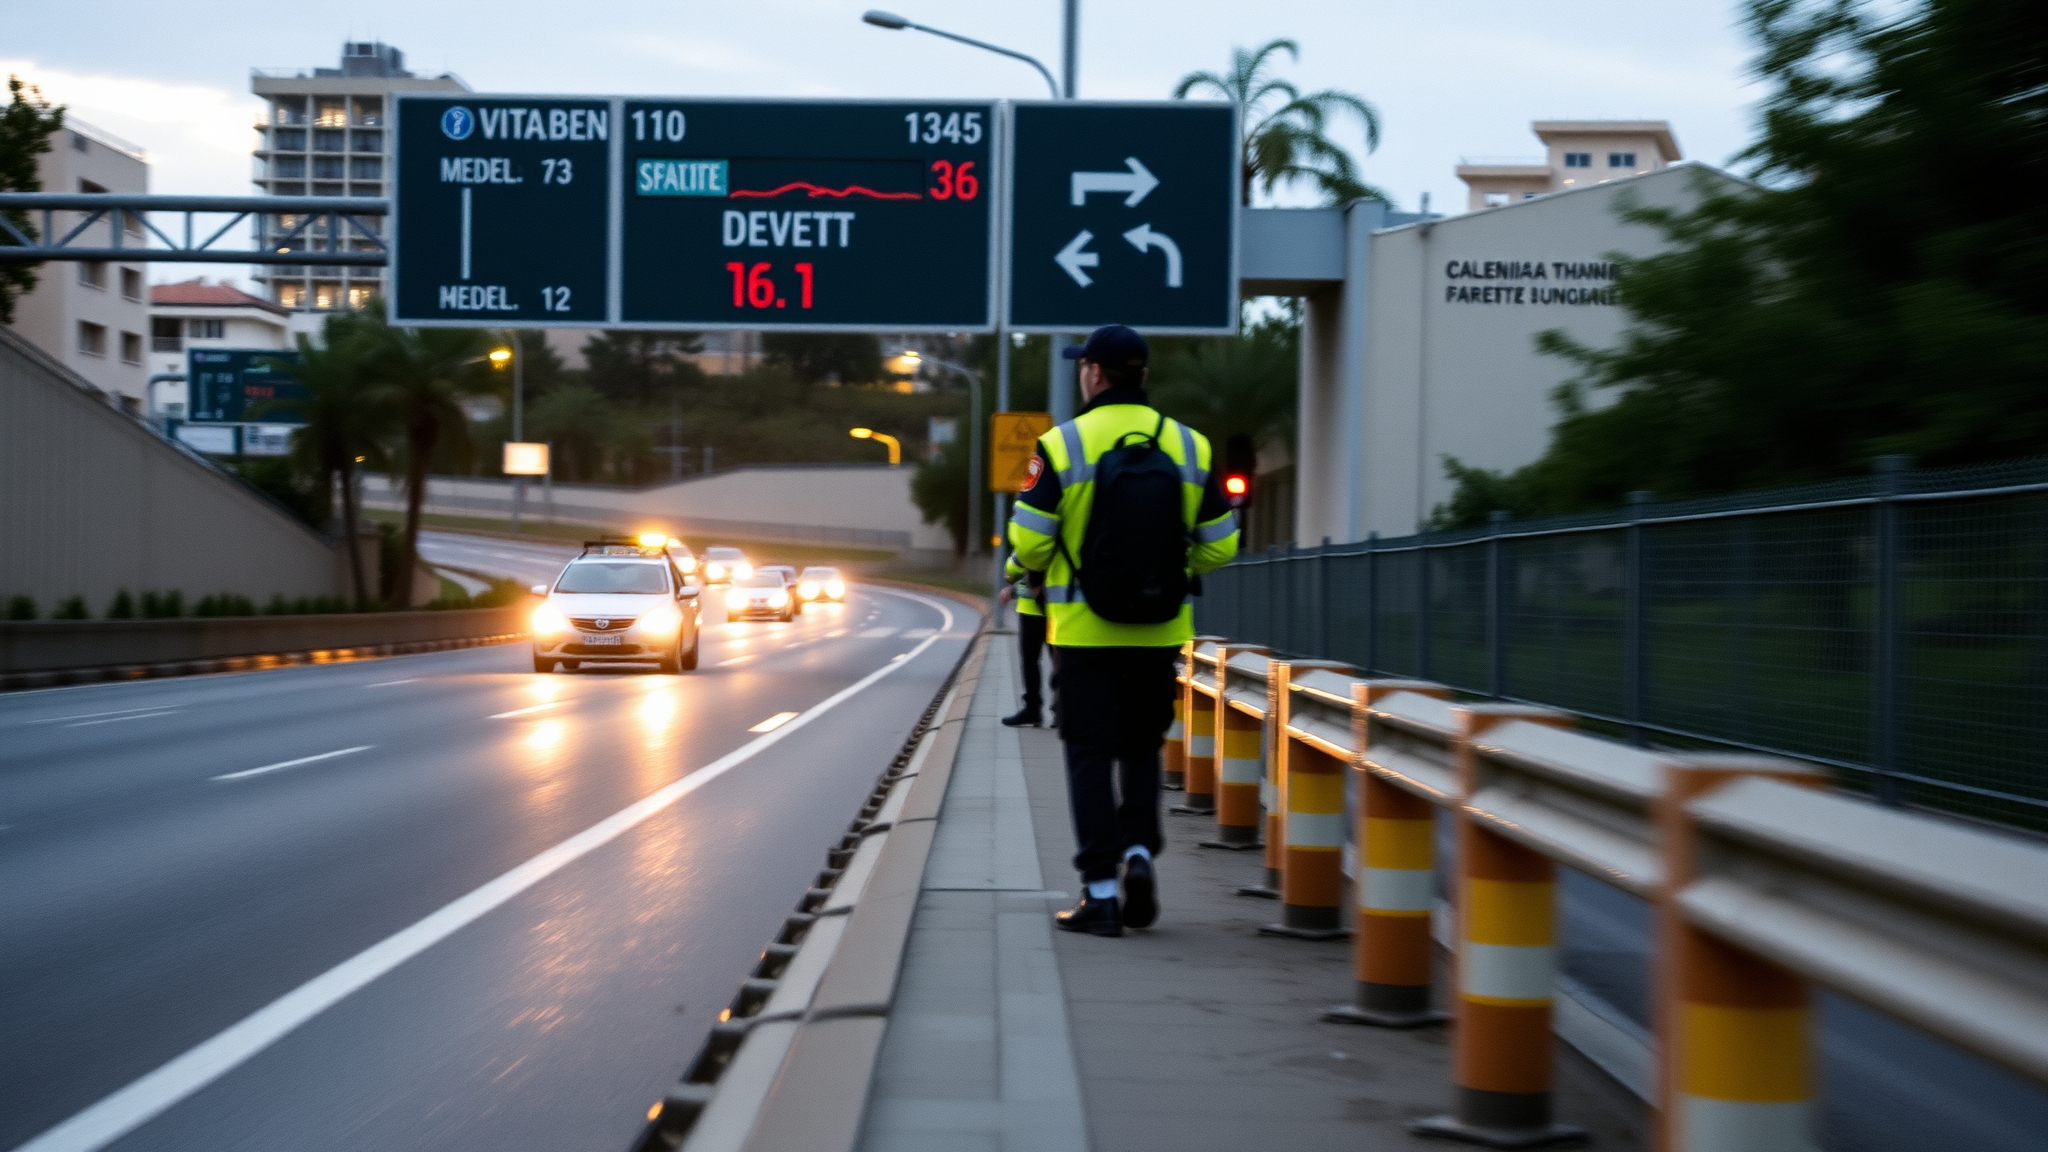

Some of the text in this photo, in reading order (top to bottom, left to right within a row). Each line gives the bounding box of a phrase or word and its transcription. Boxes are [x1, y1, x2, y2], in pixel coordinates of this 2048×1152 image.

[478, 107, 608, 141] VITABEN
[631, 109, 686, 142] 110
[905, 111, 982, 145] 1345
[440, 157, 573, 185] MEDEL. 73
[930, 159, 979, 201] 36
[722, 210, 856, 247] DEVETT
[541, 285, 571, 312] 12
